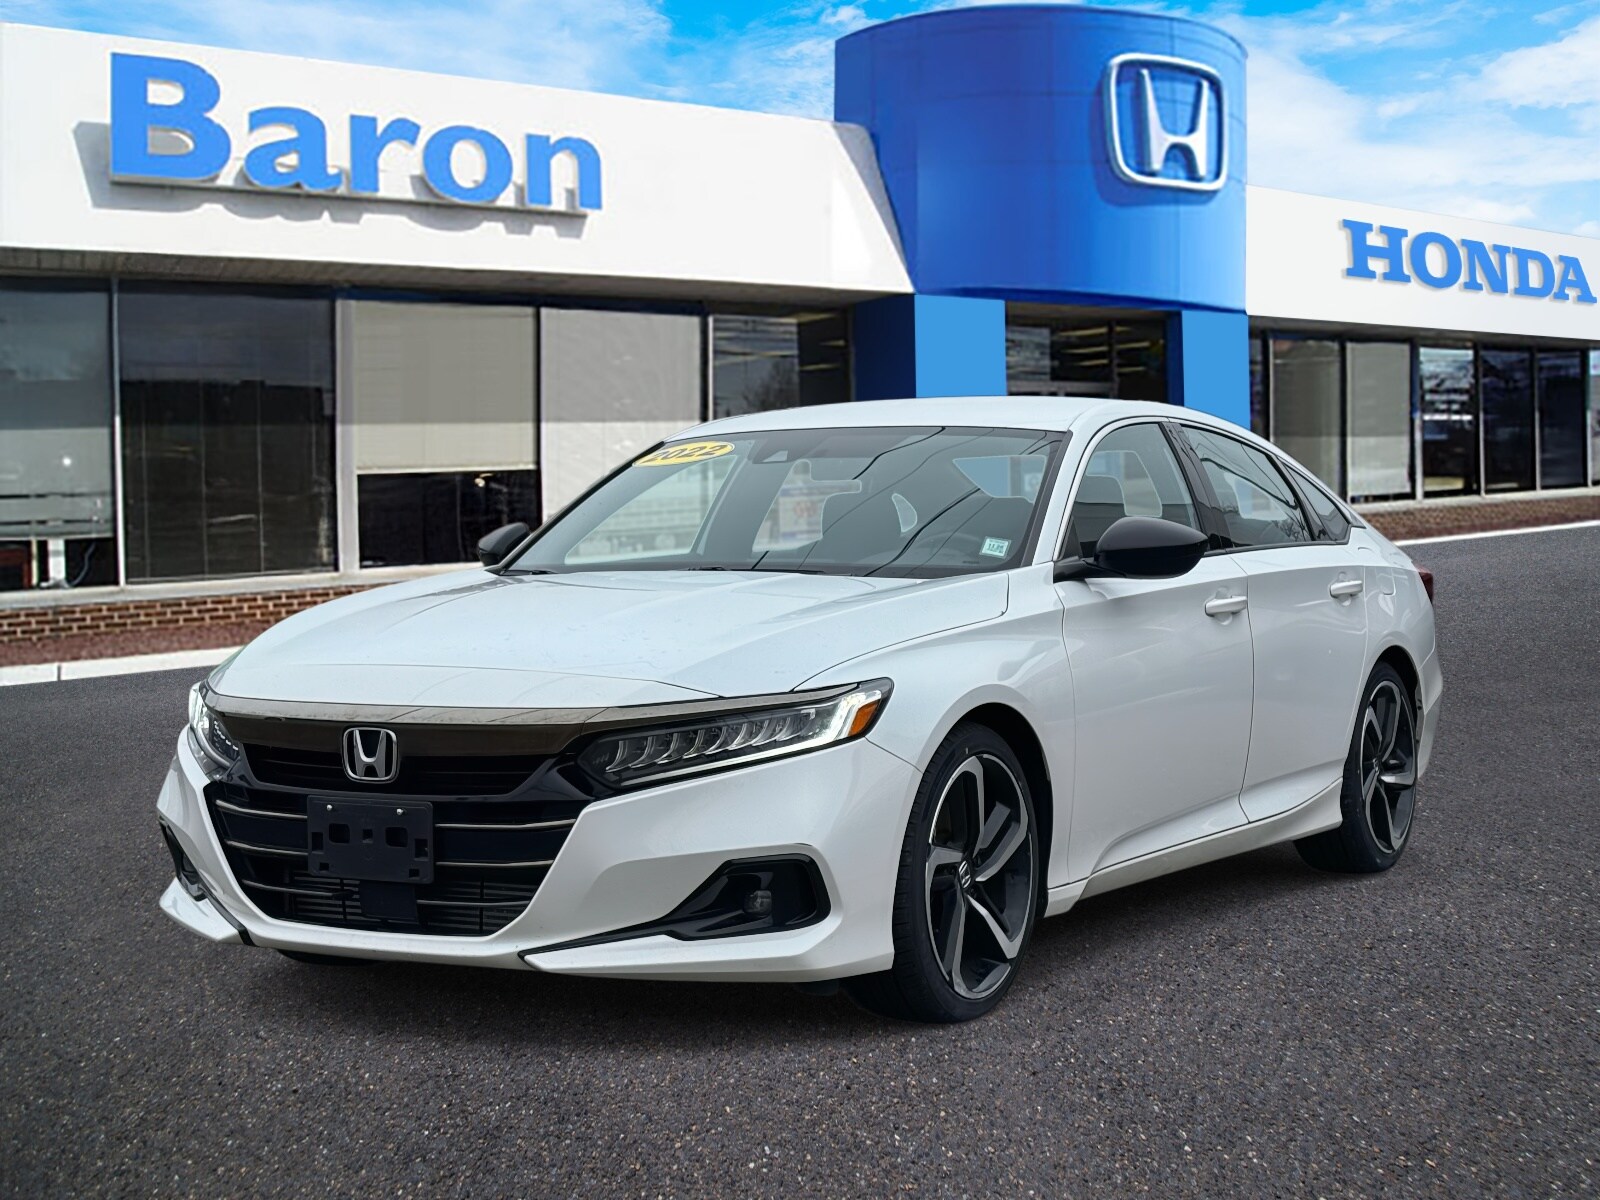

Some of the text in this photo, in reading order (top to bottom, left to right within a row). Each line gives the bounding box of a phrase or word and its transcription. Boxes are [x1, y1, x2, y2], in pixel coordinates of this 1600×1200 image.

[111, 53, 602, 209] Baron
[1343, 219, 1597, 304] HONDA
[640, 445, 729, 464] 2022
